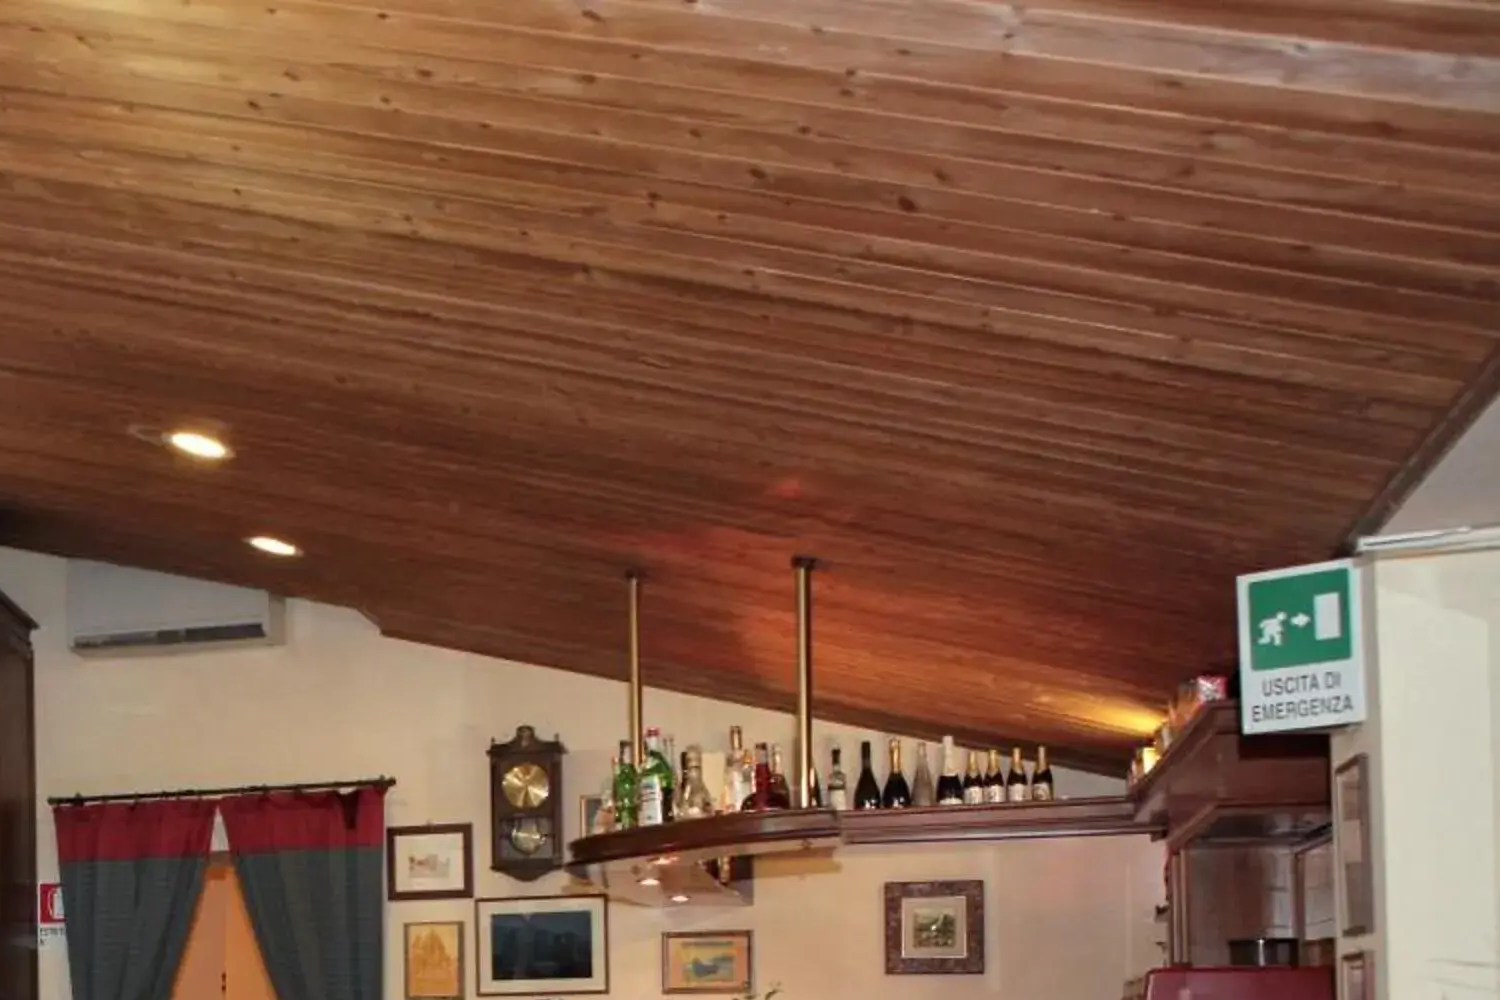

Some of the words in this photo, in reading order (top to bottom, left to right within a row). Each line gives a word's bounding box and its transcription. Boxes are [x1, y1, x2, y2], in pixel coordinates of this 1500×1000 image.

[1261, 673, 1320, 698] USCITA
[1324, 671, 1342, 689] DI
[1251, 694, 1354, 723] EMERGENZA
